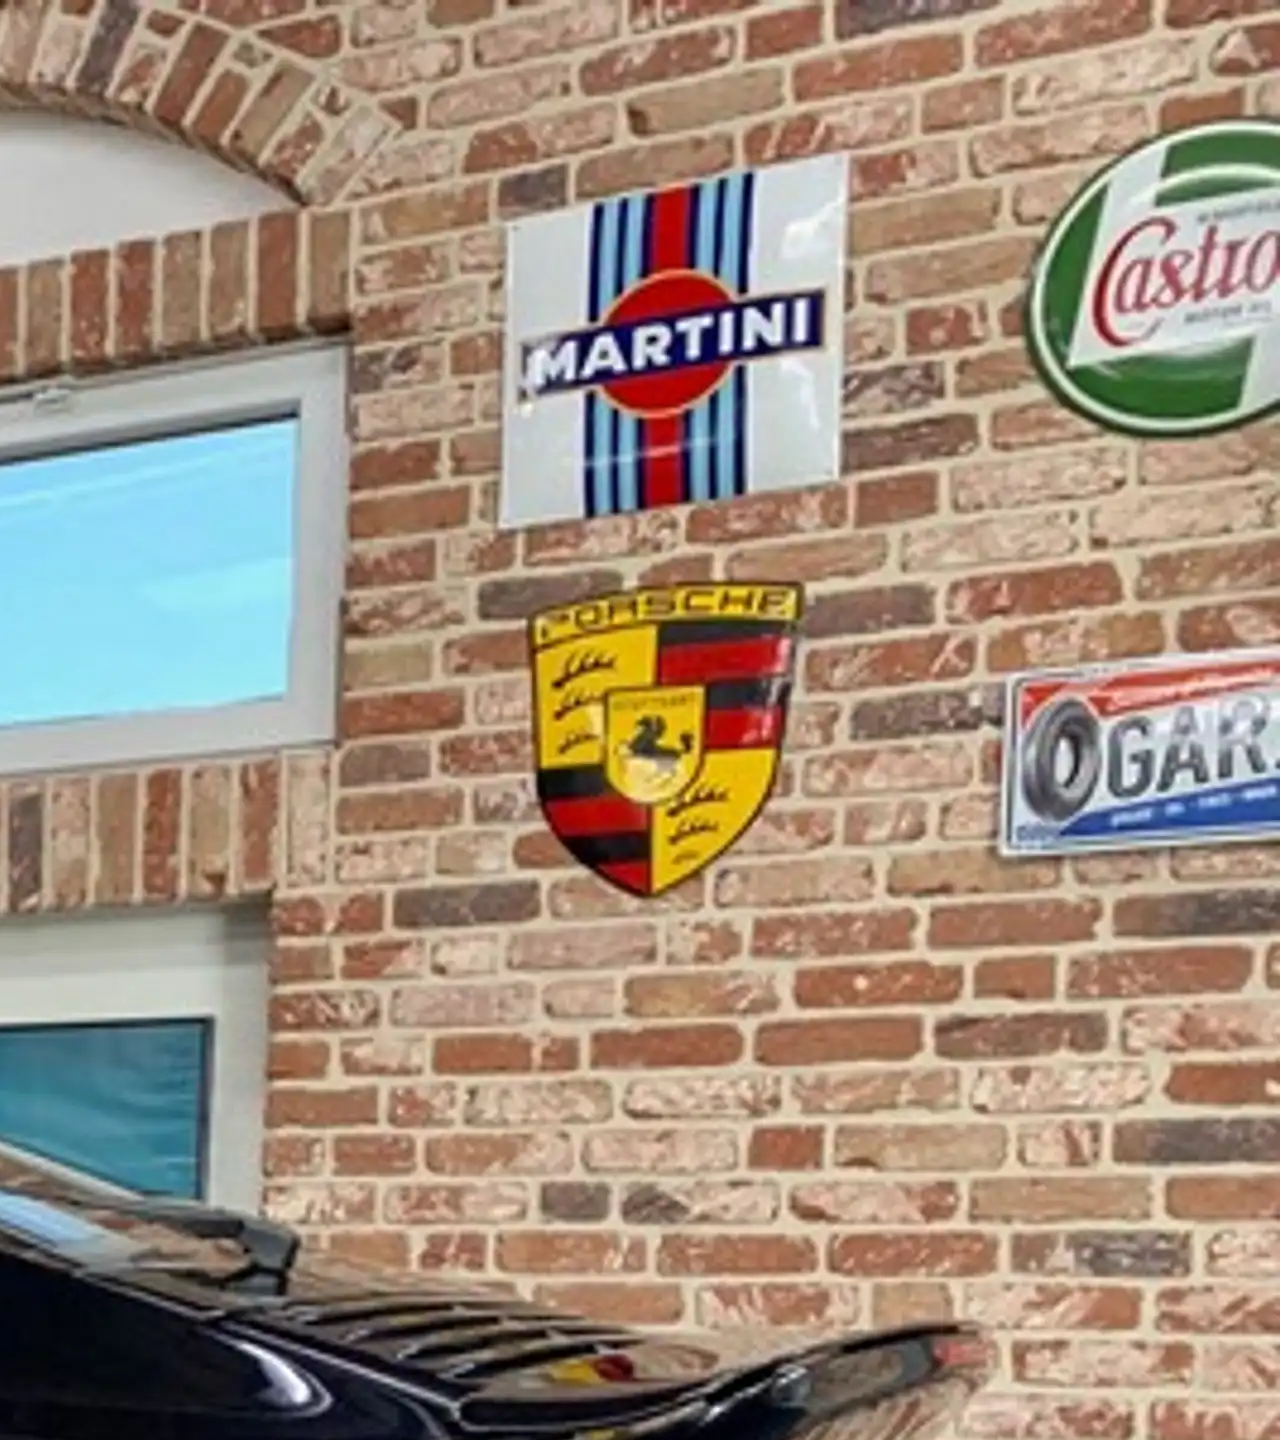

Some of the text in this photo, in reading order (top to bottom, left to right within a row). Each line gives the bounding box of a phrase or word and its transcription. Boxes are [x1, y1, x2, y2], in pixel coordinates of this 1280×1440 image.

[523, 296, 810, 389] MARTINI
[539, 587, 789, 642] PORSCHE
[1107, 692, 1280, 799] GAR
